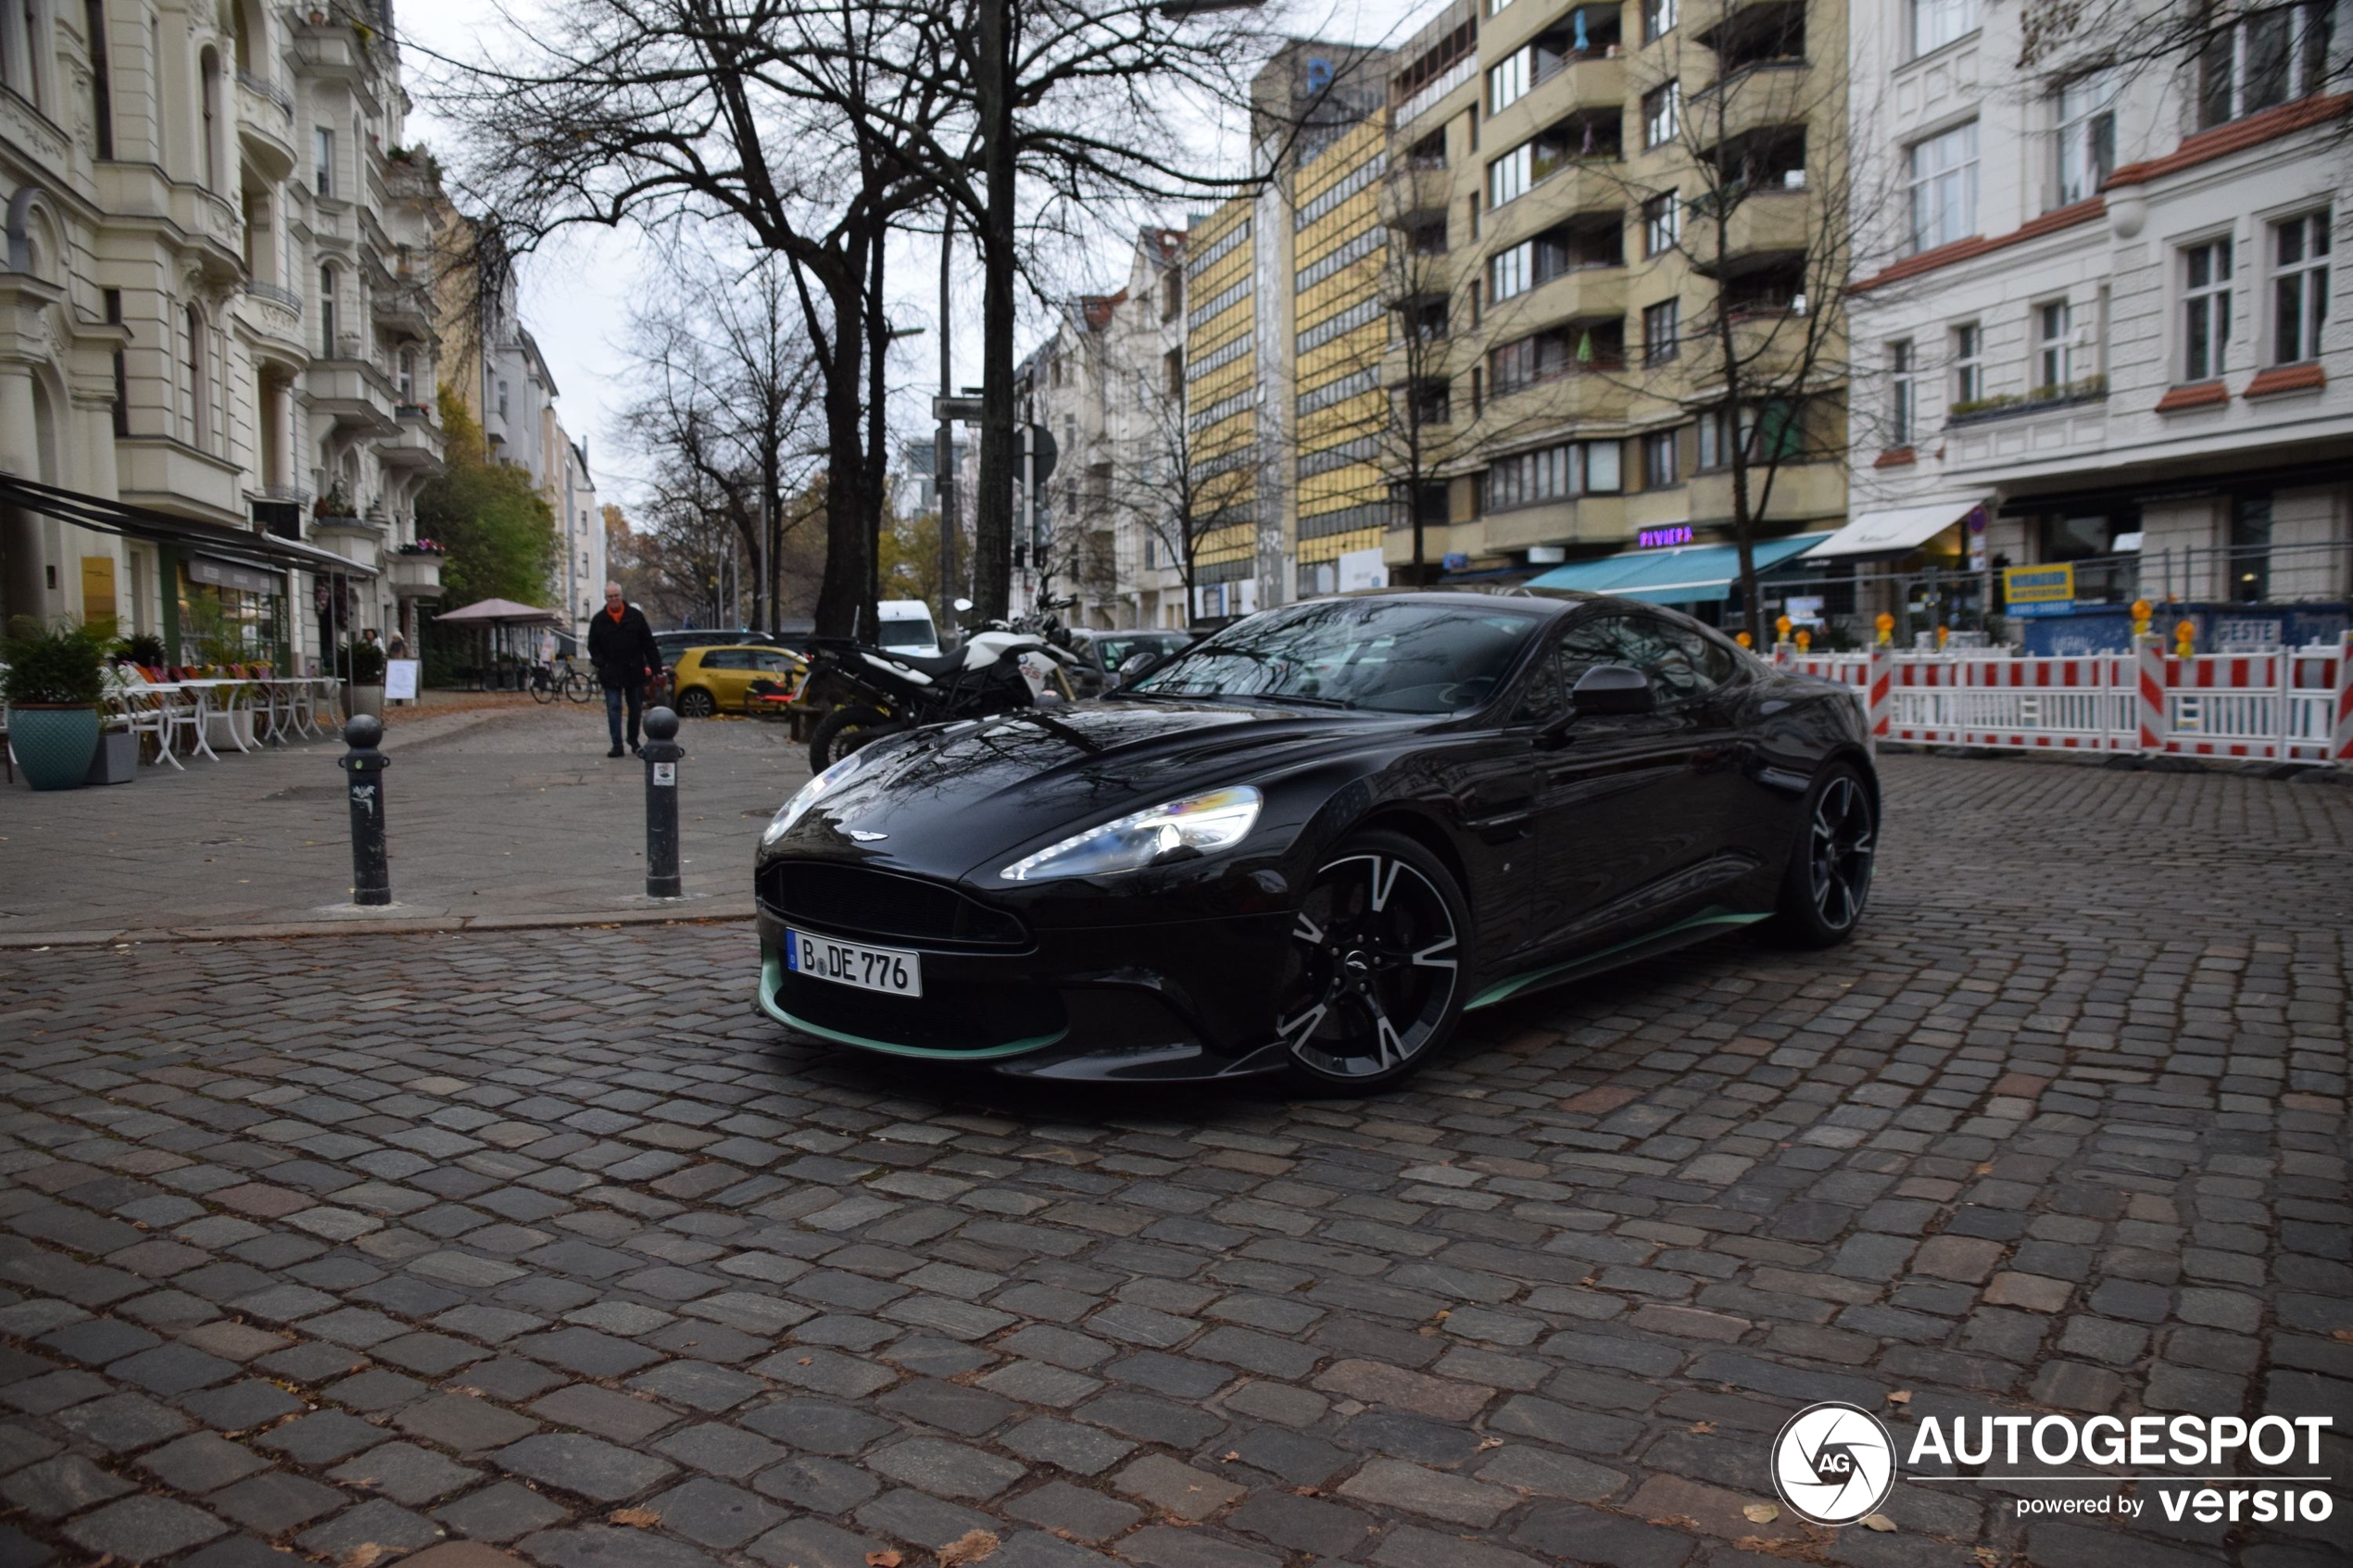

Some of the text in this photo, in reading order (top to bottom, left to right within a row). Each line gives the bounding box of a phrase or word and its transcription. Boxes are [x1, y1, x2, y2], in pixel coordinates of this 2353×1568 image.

[1640, 526, 1693, 546] RIVIERA
[1021, 665, 1042, 680] GS
[803, 938, 908, 989] B DE 776
